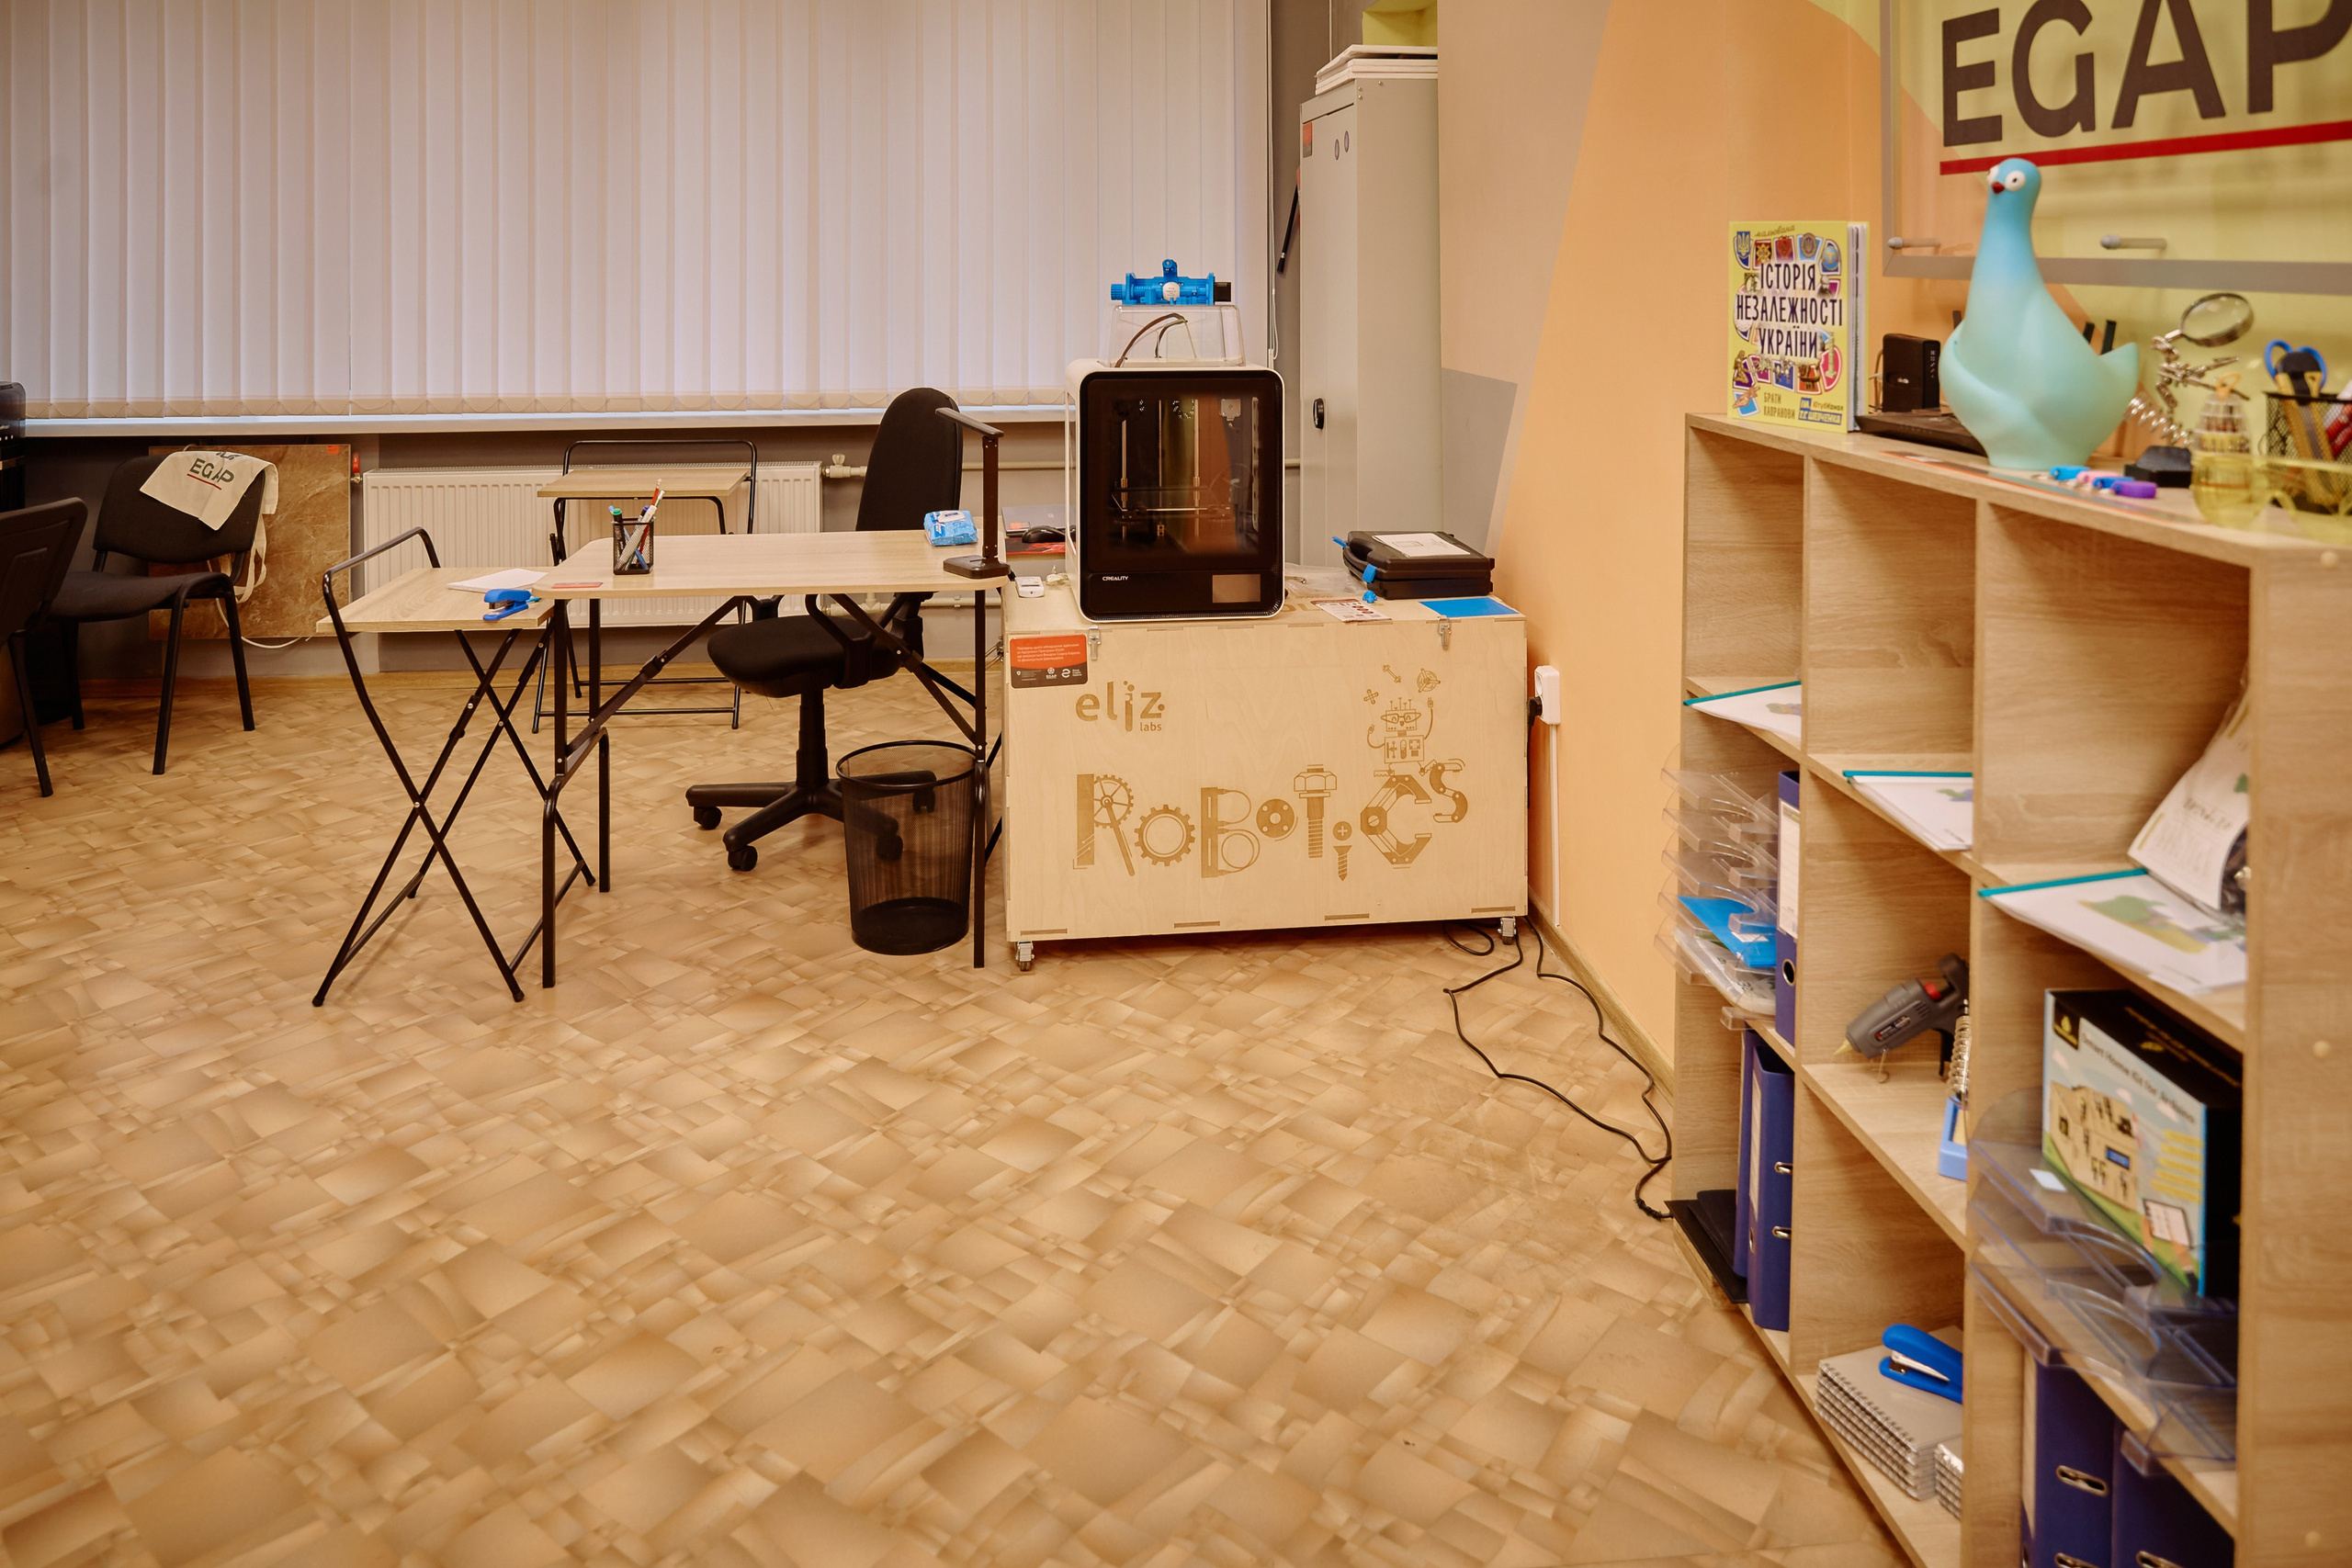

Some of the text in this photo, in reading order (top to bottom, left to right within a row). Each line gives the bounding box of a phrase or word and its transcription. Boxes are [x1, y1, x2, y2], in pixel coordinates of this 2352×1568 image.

[1942, 0, 2352, 147] EGAP
[1760, 263, 1816, 290] ІСТОРІЯ
[1736, 294, 1842, 326] НЕЗАЛЕЖНОСТІ
[1759, 325, 1818, 358] УКРАЇНИ
[1763, 392, 1781, 404] БРАТИ
[1763, 405, 1795, 420] КАПРАНОВИ
[1139, 721, 1163, 732] labs
[2105, 1052, 2130, 1077] Home
